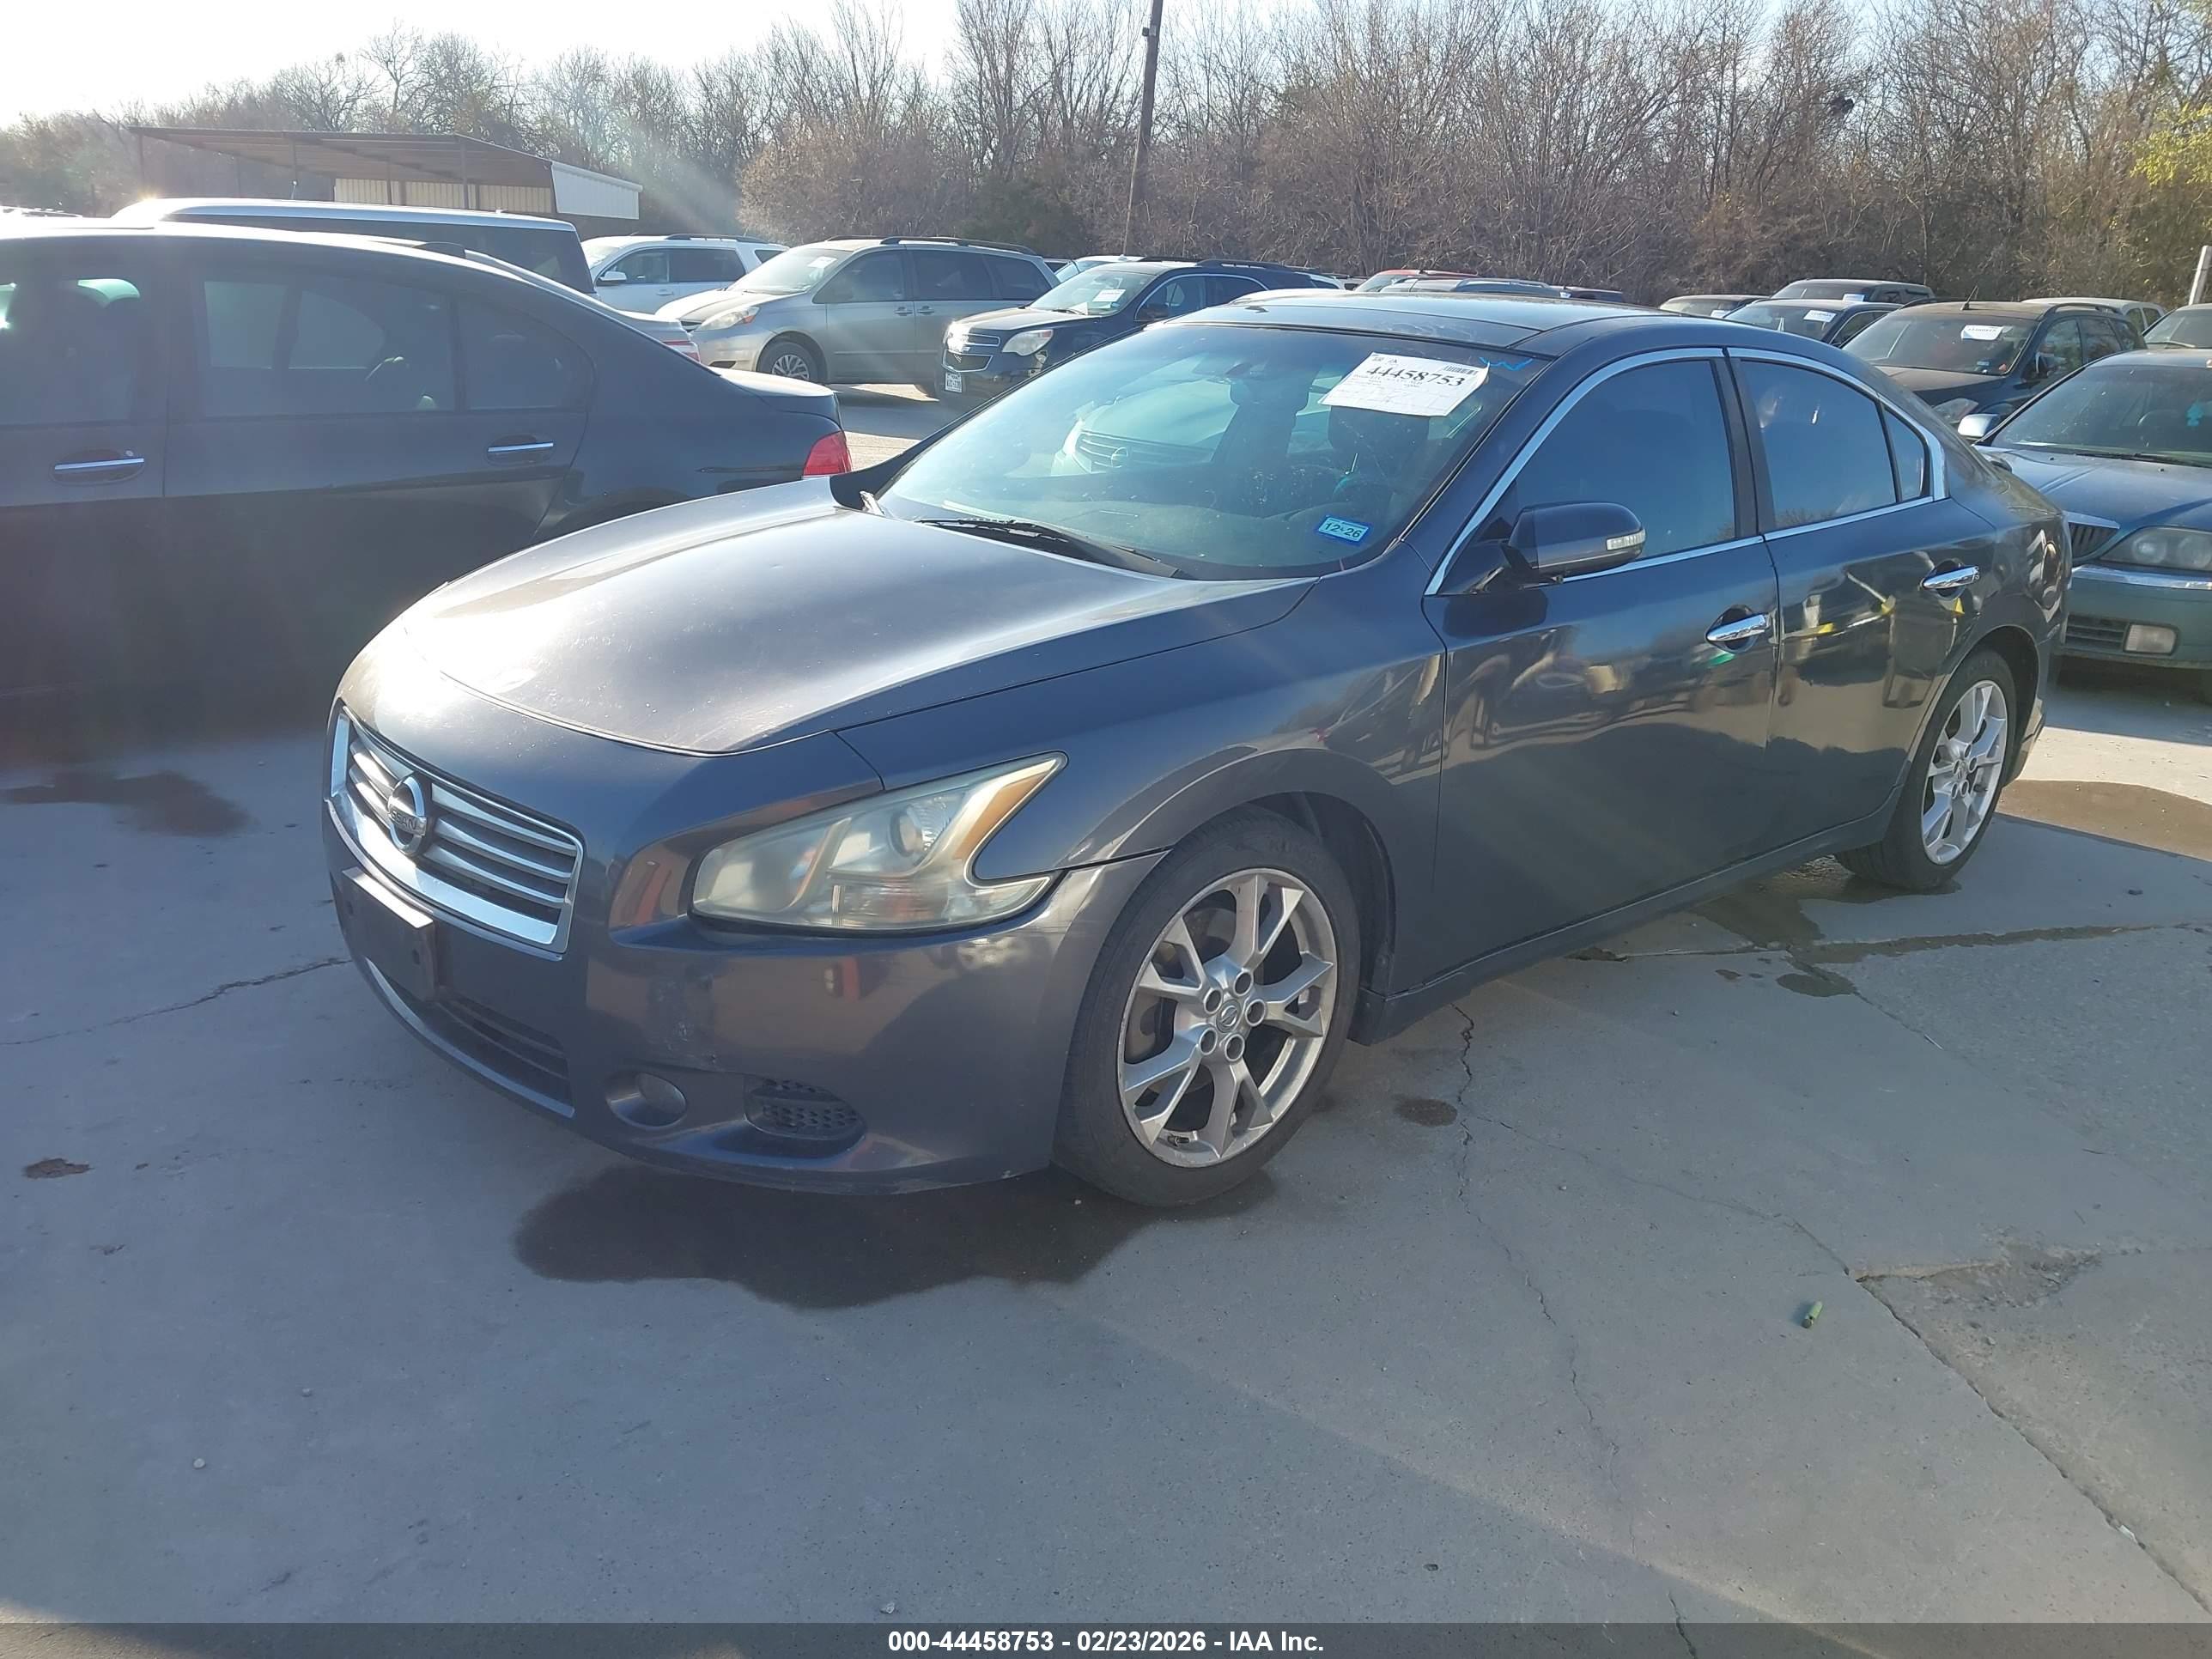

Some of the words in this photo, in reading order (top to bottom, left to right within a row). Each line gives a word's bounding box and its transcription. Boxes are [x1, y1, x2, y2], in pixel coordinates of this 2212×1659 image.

[1367, 366, 1466, 386] 44458753
[1325, 522, 1341, 532] 12
[1343, 527, 1363, 538] 26
